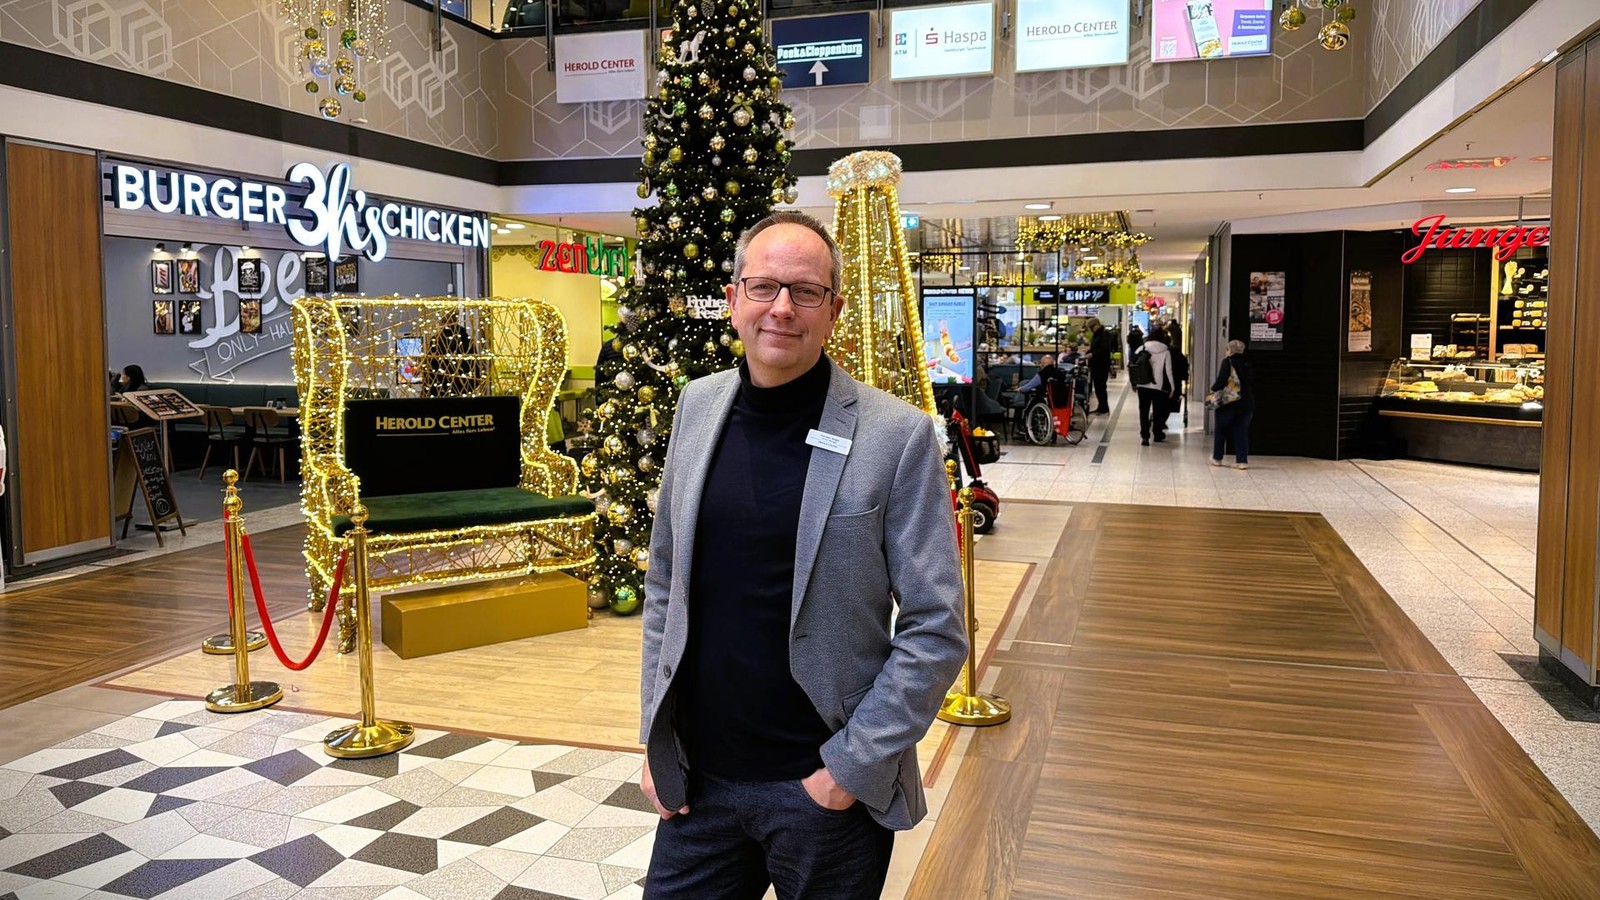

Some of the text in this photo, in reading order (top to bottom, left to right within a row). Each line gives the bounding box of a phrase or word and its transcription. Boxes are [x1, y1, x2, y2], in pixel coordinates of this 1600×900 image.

[1026, 24, 1071, 37] HEROLD
[1074, 20, 1117, 33] CENTER
[944, 30, 987, 45] Haspa
[777, 43, 863, 60] Peek&Cloppenburg
[564, 61, 599, 72] HEROLD
[600, 58, 635, 70] CENTER
[117, 162, 489, 263] BURGER 3h's CHICKEN
[1401, 213, 1549, 265] Junge
[375, 414, 494, 430] HEROLD CENTER
